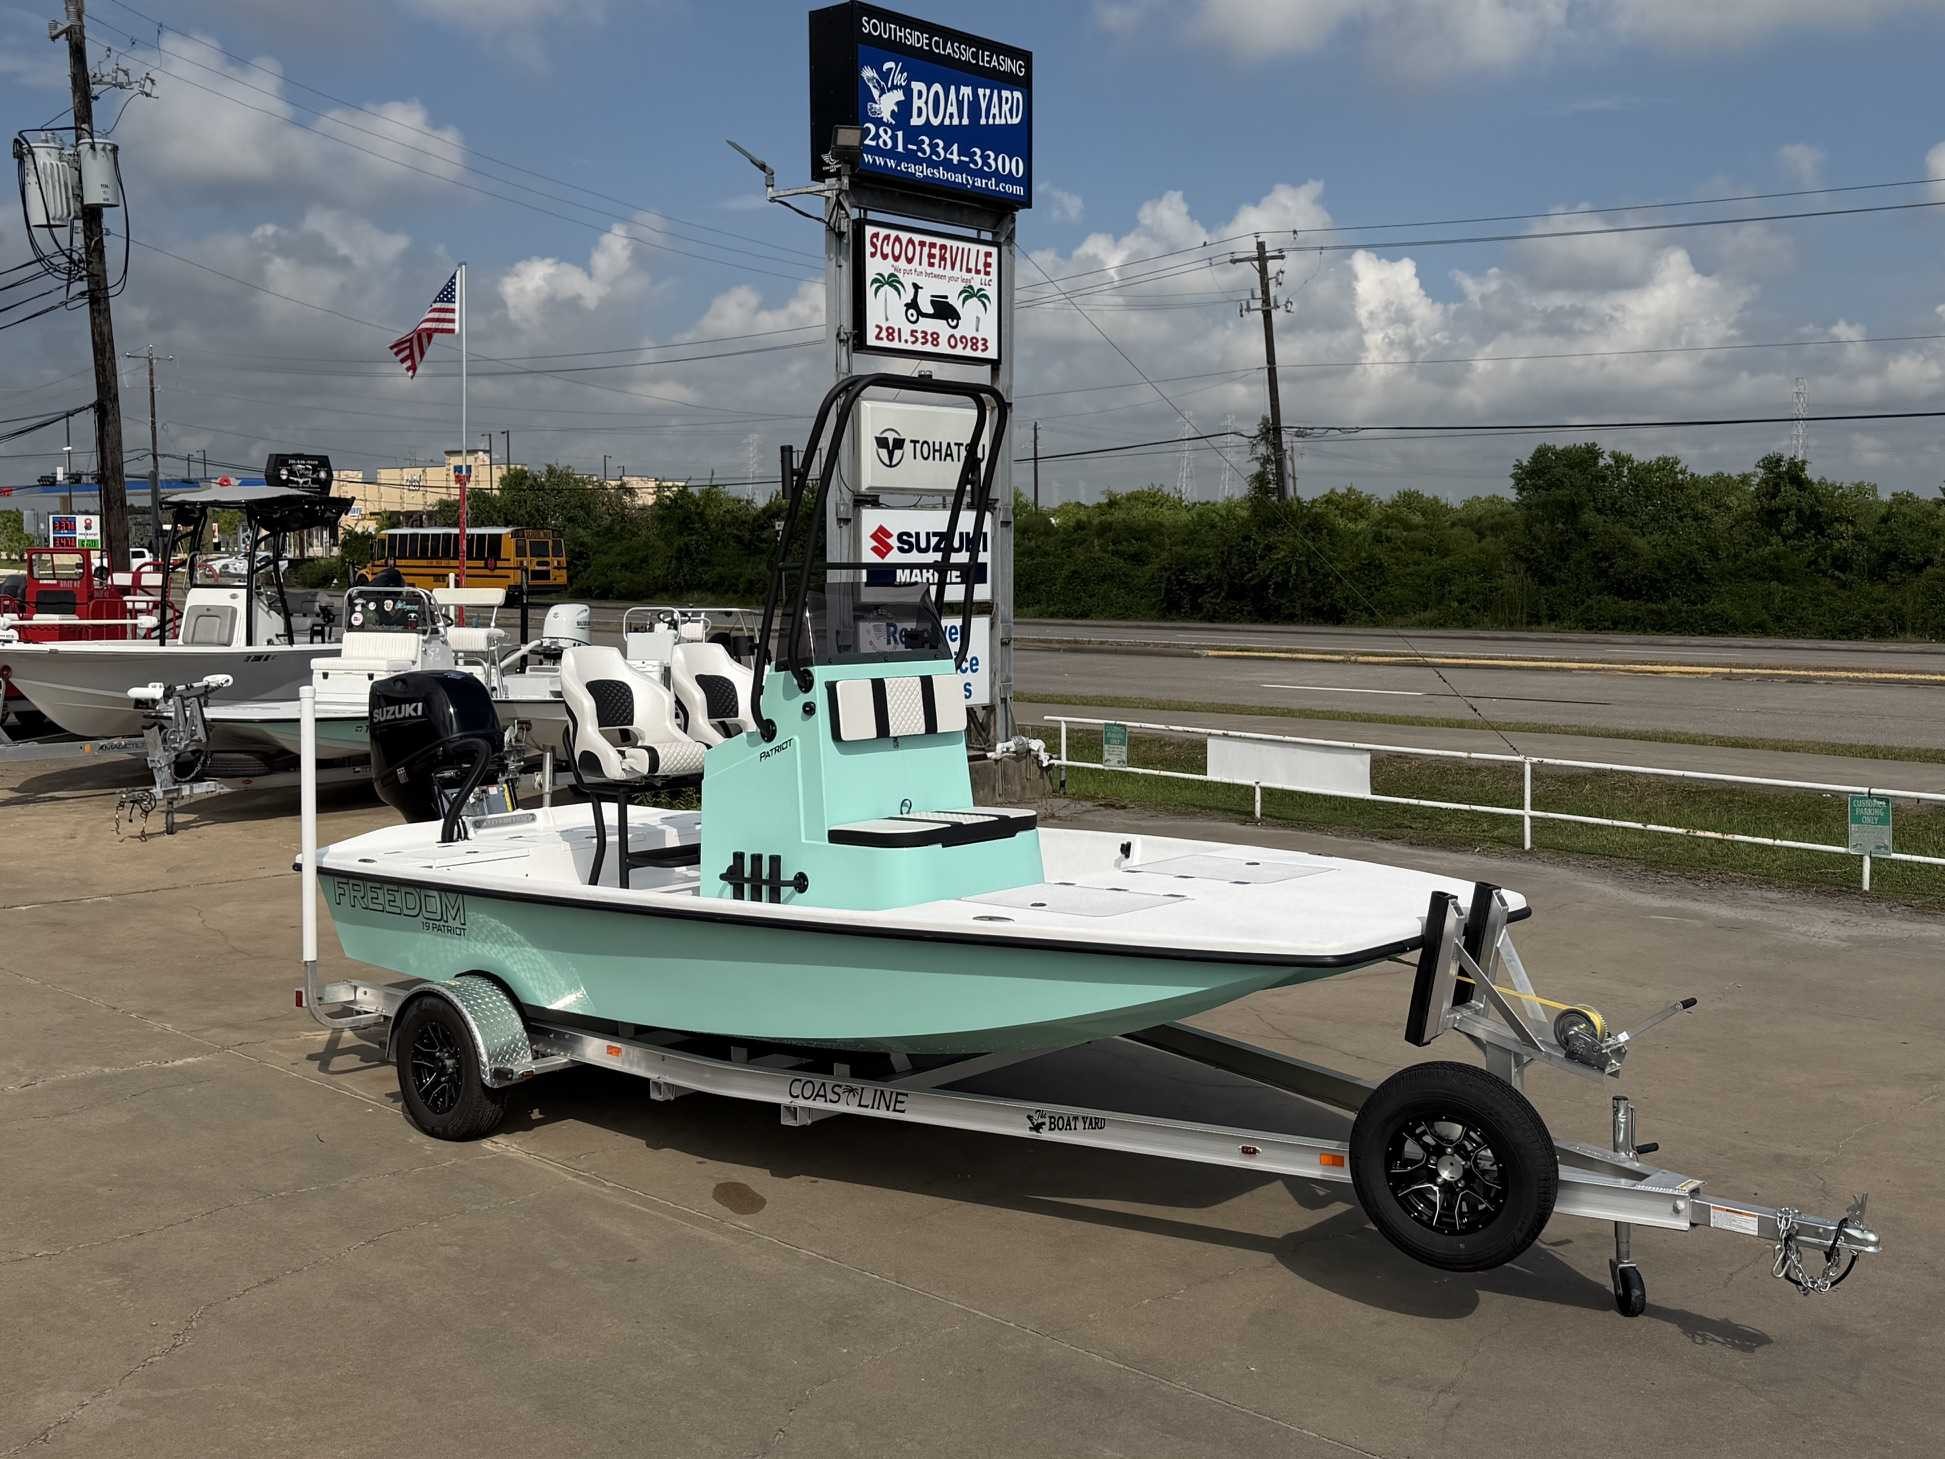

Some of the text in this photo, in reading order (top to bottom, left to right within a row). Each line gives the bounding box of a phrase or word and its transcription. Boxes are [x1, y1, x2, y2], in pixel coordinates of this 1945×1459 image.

[861, 17, 1025, 76] SOUTHSIDE CLASSIC LEASING
[882, 61, 907, 87] The
[910, 82, 1023, 127] BOAT YARD
[863, 123, 1024, 178] 281-334-3300
[862, 152, 1024, 196] www.eaglesboatyard.com
[869, 232, 993, 277] SCOOTERVILLE
[980, 278, 993, 287] LLC
[874, 324, 989, 353] 281.538 0983
[373, 702, 423, 723] SUZUKI
[760, 738, 793, 762] PATRIOT
[333, 878, 467, 926] FREEDOM
[421, 921, 467, 937] 19 PATRIOT
[1049, 1116, 1106, 1131] BOAT YARD
